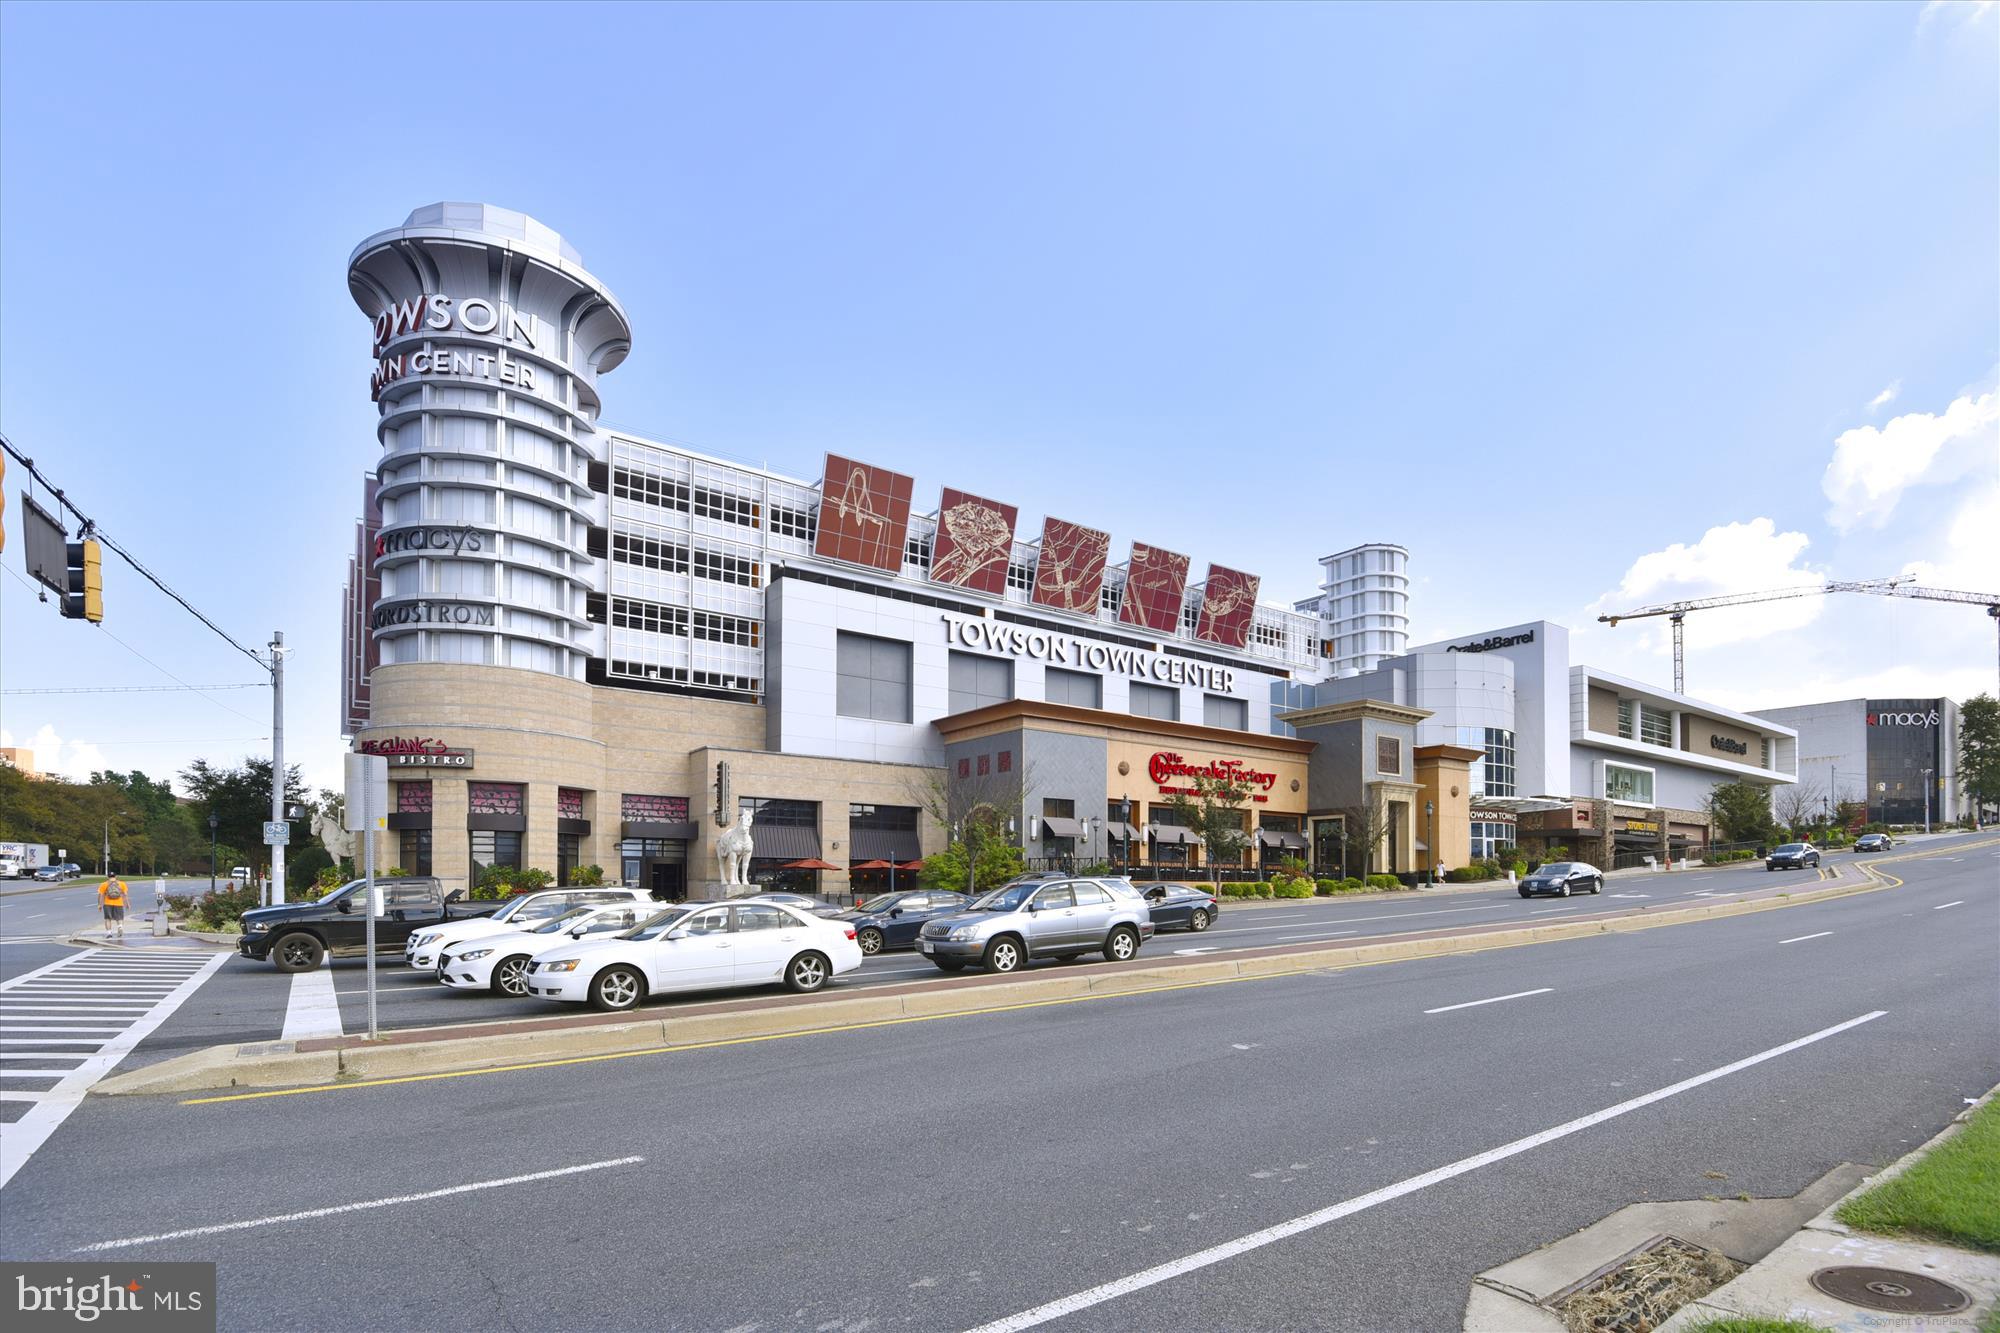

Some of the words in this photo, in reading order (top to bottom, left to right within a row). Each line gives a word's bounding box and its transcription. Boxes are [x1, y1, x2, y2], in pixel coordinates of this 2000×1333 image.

[374, 294, 538, 350] OWSON
[411, 350, 535, 390] CENTER
[386, 526, 482, 556] macy's
[372, 603, 494, 631] NORDSTROM
[941, 615, 1067, 663] TOWSON
[1072, 640, 1147, 678] TOWN
[1153, 656, 1235, 694] CENTER
[1879, 709, 1940, 728] macy's
[400, 755, 465, 765] BISTRO
[1149, 752, 1227, 784] Cheesecake
[1220, 760, 1277, 791] Factory
[1470, 811, 1498, 820] OWSON
